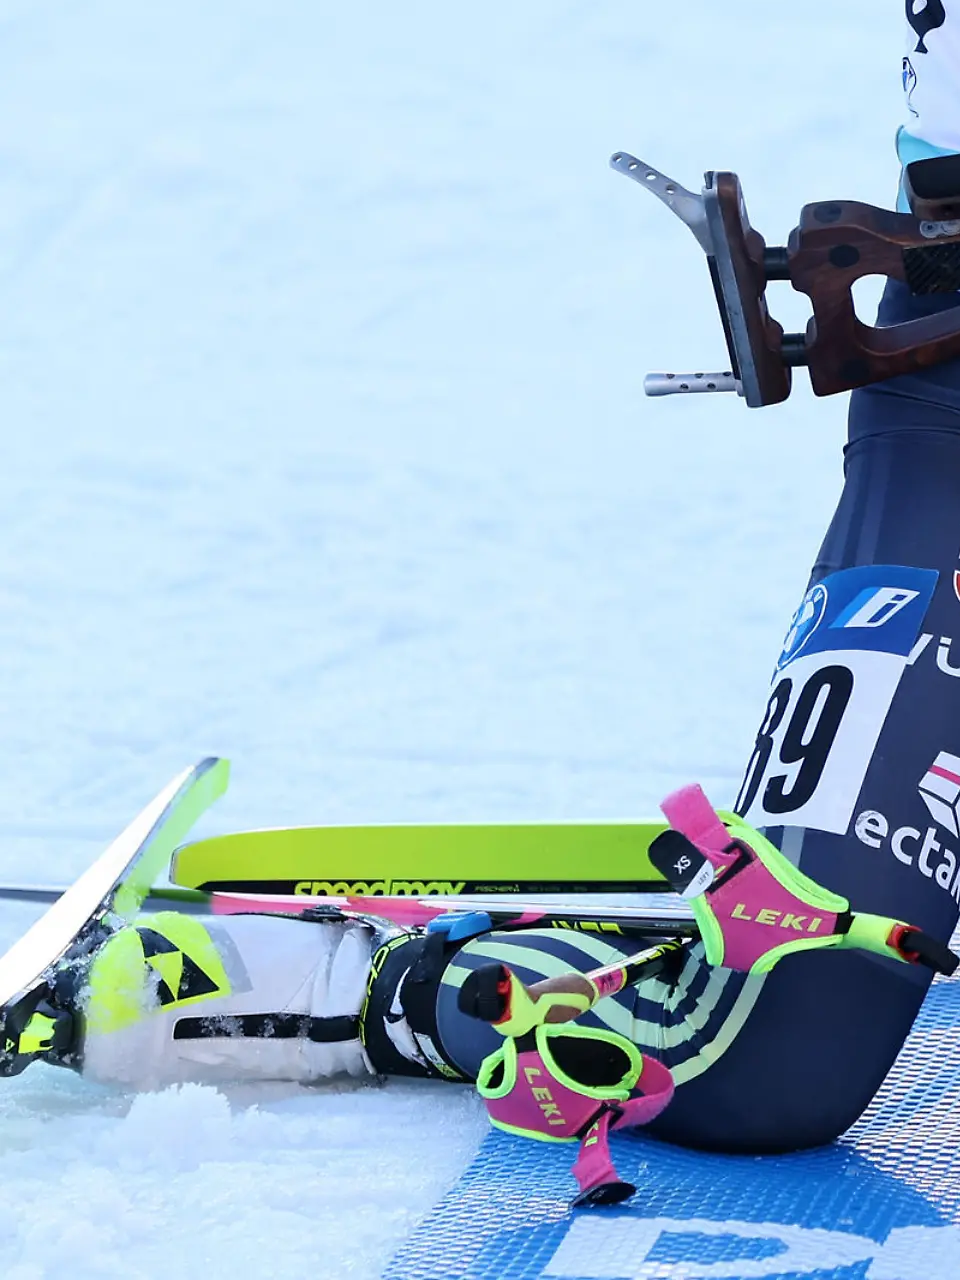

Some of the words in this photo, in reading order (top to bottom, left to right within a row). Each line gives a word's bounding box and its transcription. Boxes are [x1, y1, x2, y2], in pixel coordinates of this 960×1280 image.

[733, 664, 854, 819] 89
[673, 855, 691, 874] XS
[731, 903, 822, 932] LEKI
[524, 1067, 567, 1127] LEKI
